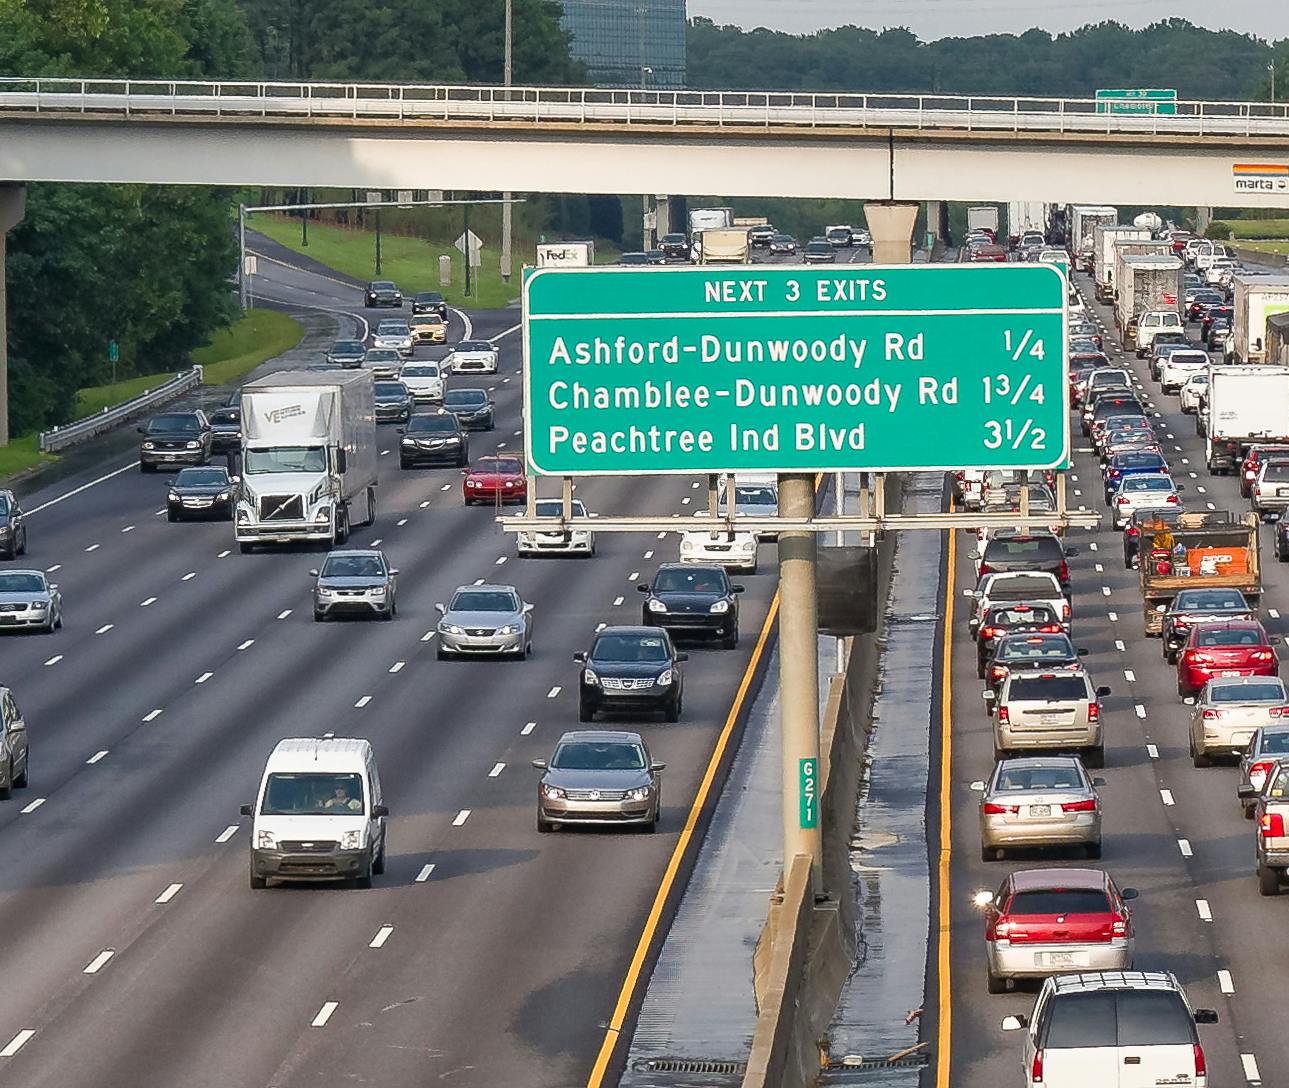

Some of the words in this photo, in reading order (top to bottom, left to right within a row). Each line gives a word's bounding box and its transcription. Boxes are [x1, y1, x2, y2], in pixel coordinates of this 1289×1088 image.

[1235, 179, 1273, 190] marta
[546, 249, 579, 261] FedEx
[704, 280, 768, 303] NEXT
[785, 280, 801, 302] 3
[817, 279, 888, 302] EXITS
[548, 333, 868, 368] Ashford-Dunwoody
[883, 331, 924, 361] Rd
[548, 378, 903, 414] Chamblee-Dunwoody
[918, 376, 959, 405] Rd
[548, 423, 713, 455] Peachtree
[730, 422, 780, 452] Ind
[794, 421, 866, 451] Blvd
